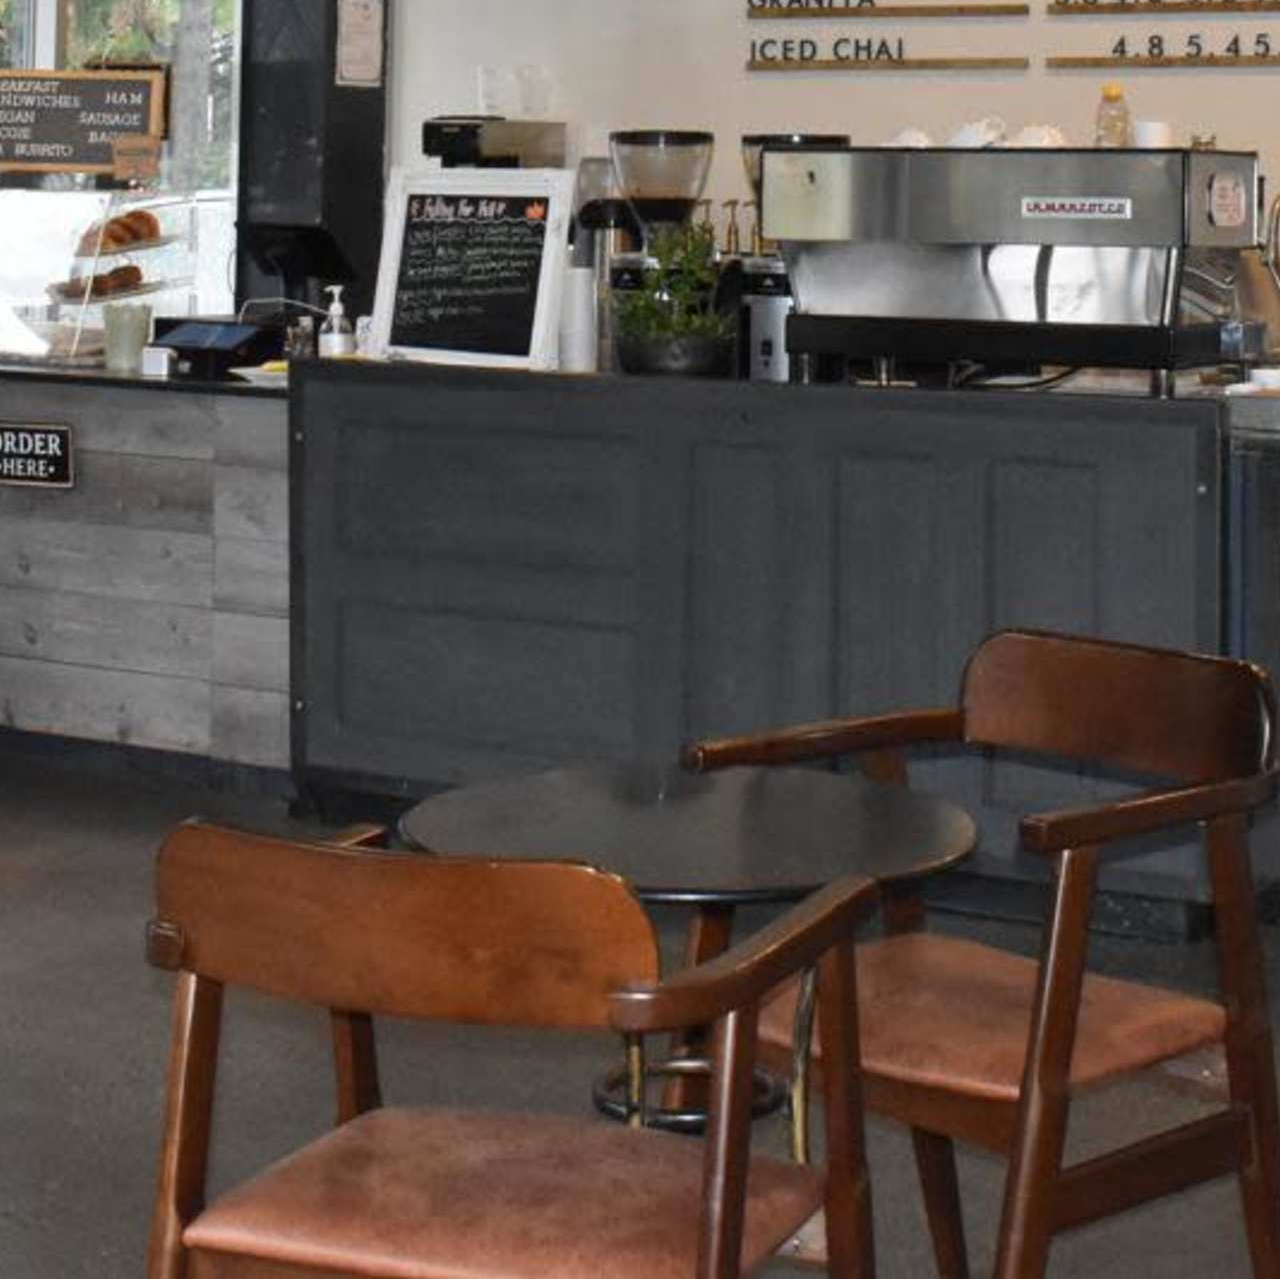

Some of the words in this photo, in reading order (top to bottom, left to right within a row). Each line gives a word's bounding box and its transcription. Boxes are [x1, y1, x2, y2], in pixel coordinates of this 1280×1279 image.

[750, 39, 817, 62] ICED
[832, 38, 904, 62] CHAI
[1112, 35, 1164, 58] 4.8
[1187, 34, 1240, 58] 5.4
[105, 91, 143, 105] HAM
